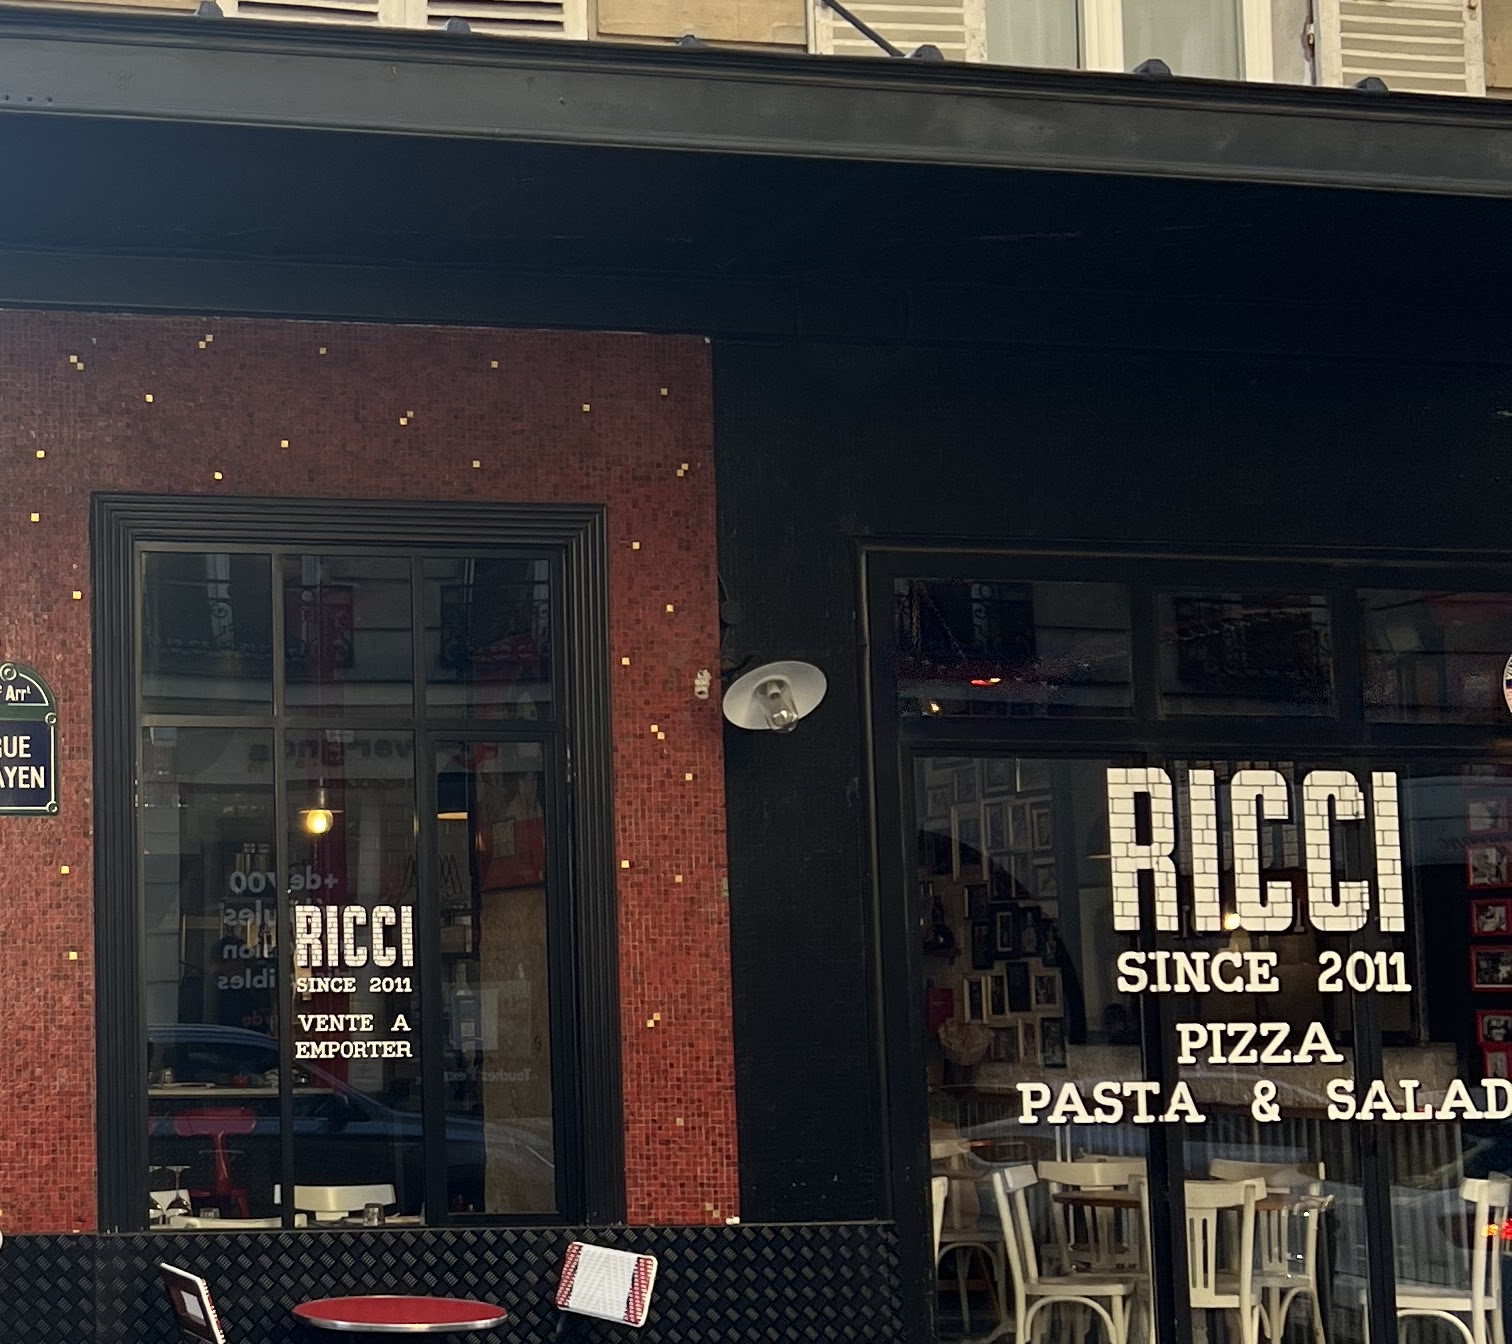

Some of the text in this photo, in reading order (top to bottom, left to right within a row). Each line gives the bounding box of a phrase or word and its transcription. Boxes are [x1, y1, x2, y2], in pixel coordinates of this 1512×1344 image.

[1106, 767, 1405, 932] RICCI
[295, 905, 414, 967] RICCI
[296, 977, 356, 993] SINCE
[369, 977, 413, 993] 2011
[1117, 951, 1412, 993] SINCE 2011
[297, 1014, 412, 1032] VENTE A
[1175, 1022, 1345, 1064] PIZZA
[295, 1041, 414, 1059] EMPORTER
[1016, 1081, 1206, 1124] PASTA
[1251, 1080, 1281, 1122] &
